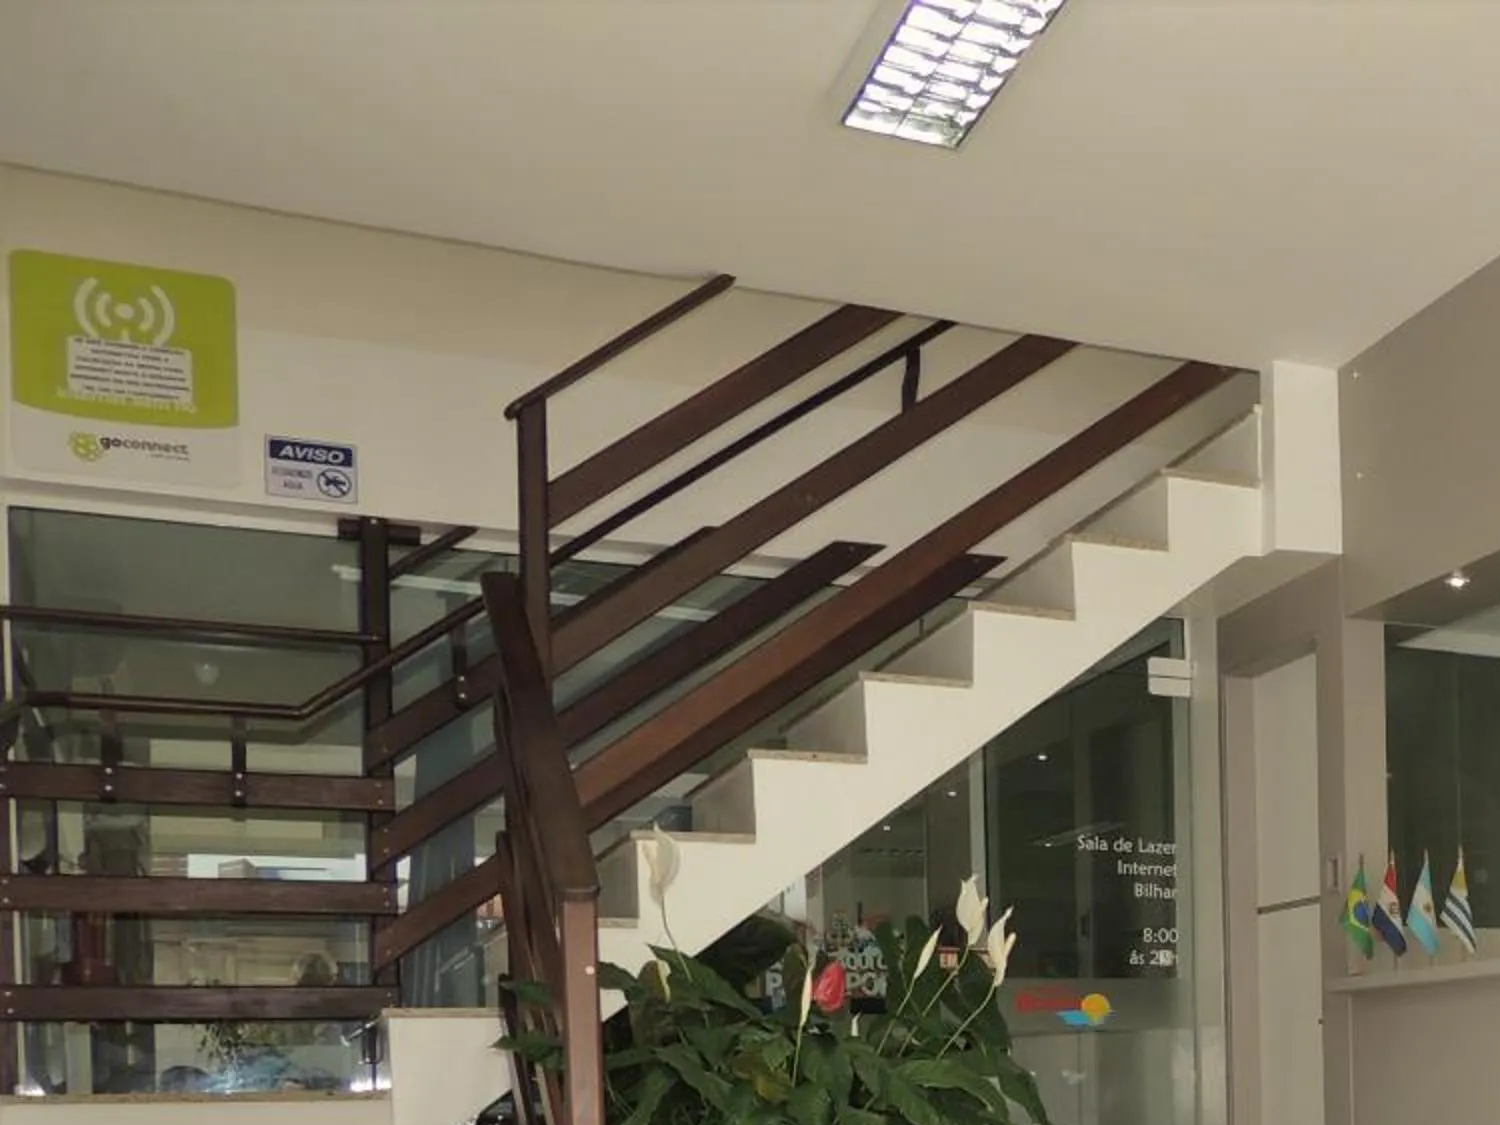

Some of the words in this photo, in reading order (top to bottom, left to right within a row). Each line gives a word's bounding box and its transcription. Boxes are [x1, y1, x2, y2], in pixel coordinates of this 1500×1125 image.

[279, 444, 345, 464] AVISO
[1077, 834, 1108, 851] Sala
[1113, 837, 1133, 852] de
[1138, 838, 1177, 855] Lazer
[1117, 859, 1178, 877] Internet
[1134, 883, 1178, 900] Bilhar
[1143, 927, 1179, 943] 8:00
